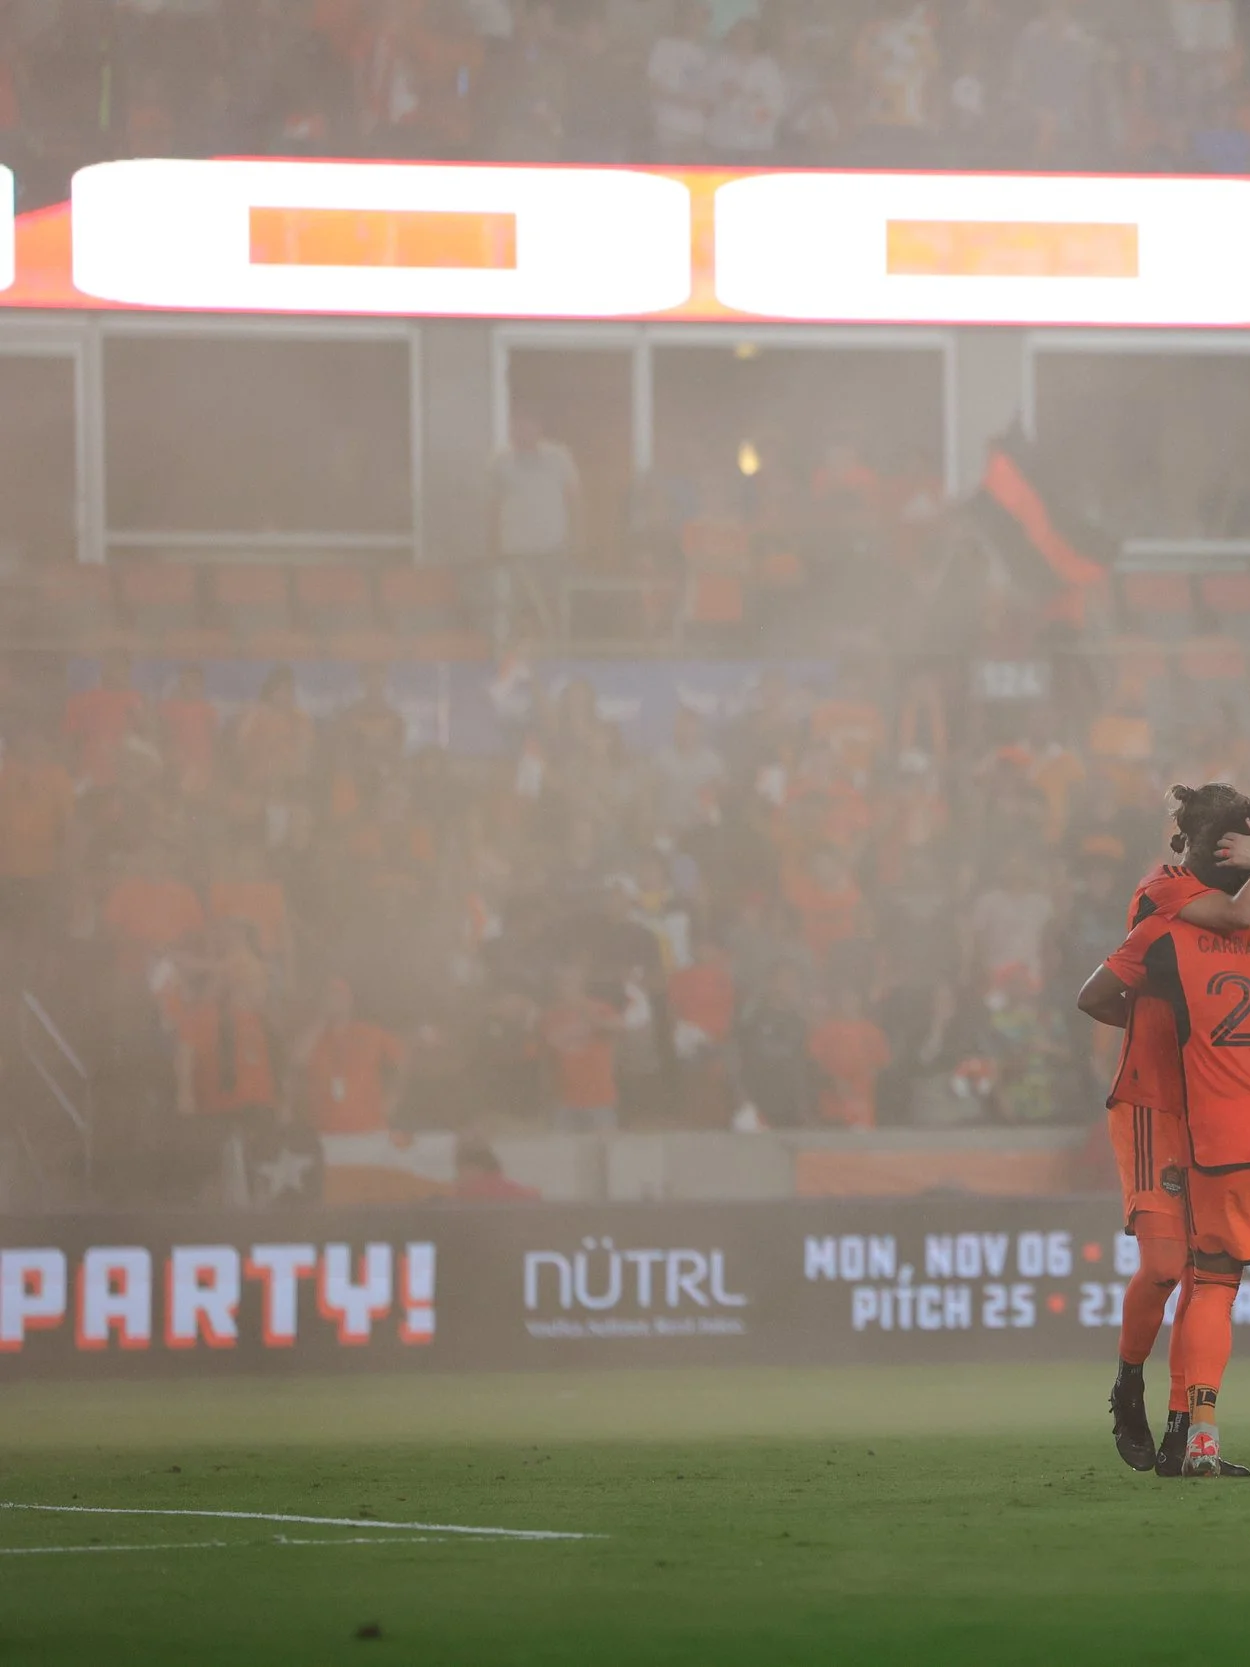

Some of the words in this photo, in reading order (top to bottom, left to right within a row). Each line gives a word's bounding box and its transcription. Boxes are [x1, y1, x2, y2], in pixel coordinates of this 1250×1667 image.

[804, 1234, 914, 1287] MON,
[925, 1233, 1008, 1278] NOV
[1017, 1231, 1072, 1277] 06
[0, 1242, 436, 1349] PARTY!
[852, 1284, 972, 1330] PITCH
[982, 1283, 1036, 1328] 25
